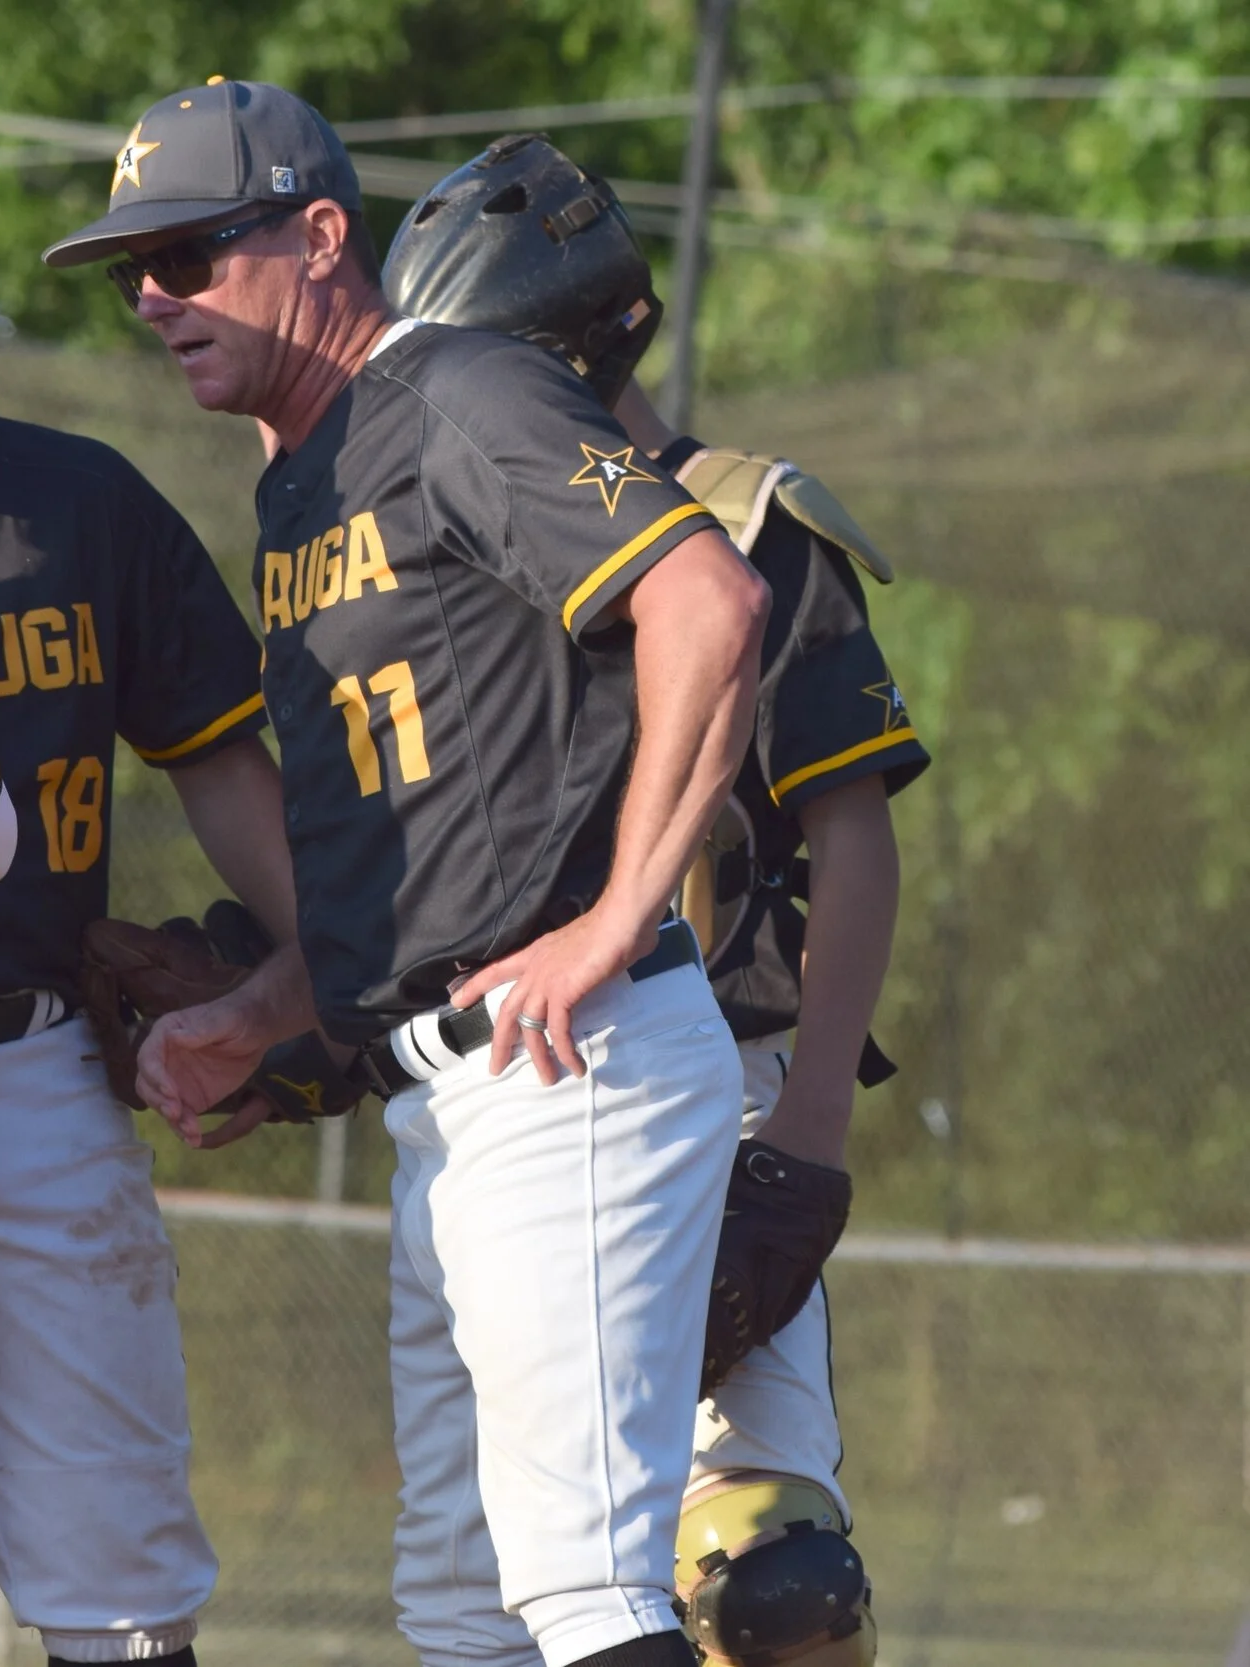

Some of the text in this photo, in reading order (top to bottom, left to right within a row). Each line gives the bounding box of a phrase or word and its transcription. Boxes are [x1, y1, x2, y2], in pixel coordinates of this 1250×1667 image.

[121, 147, 133, 169] A
[601, 460, 628, 482] A
[263, 511, 398, 634] AUGA
[330, 660, 431, 797] 11
[37, 756, 104, 872] 18
